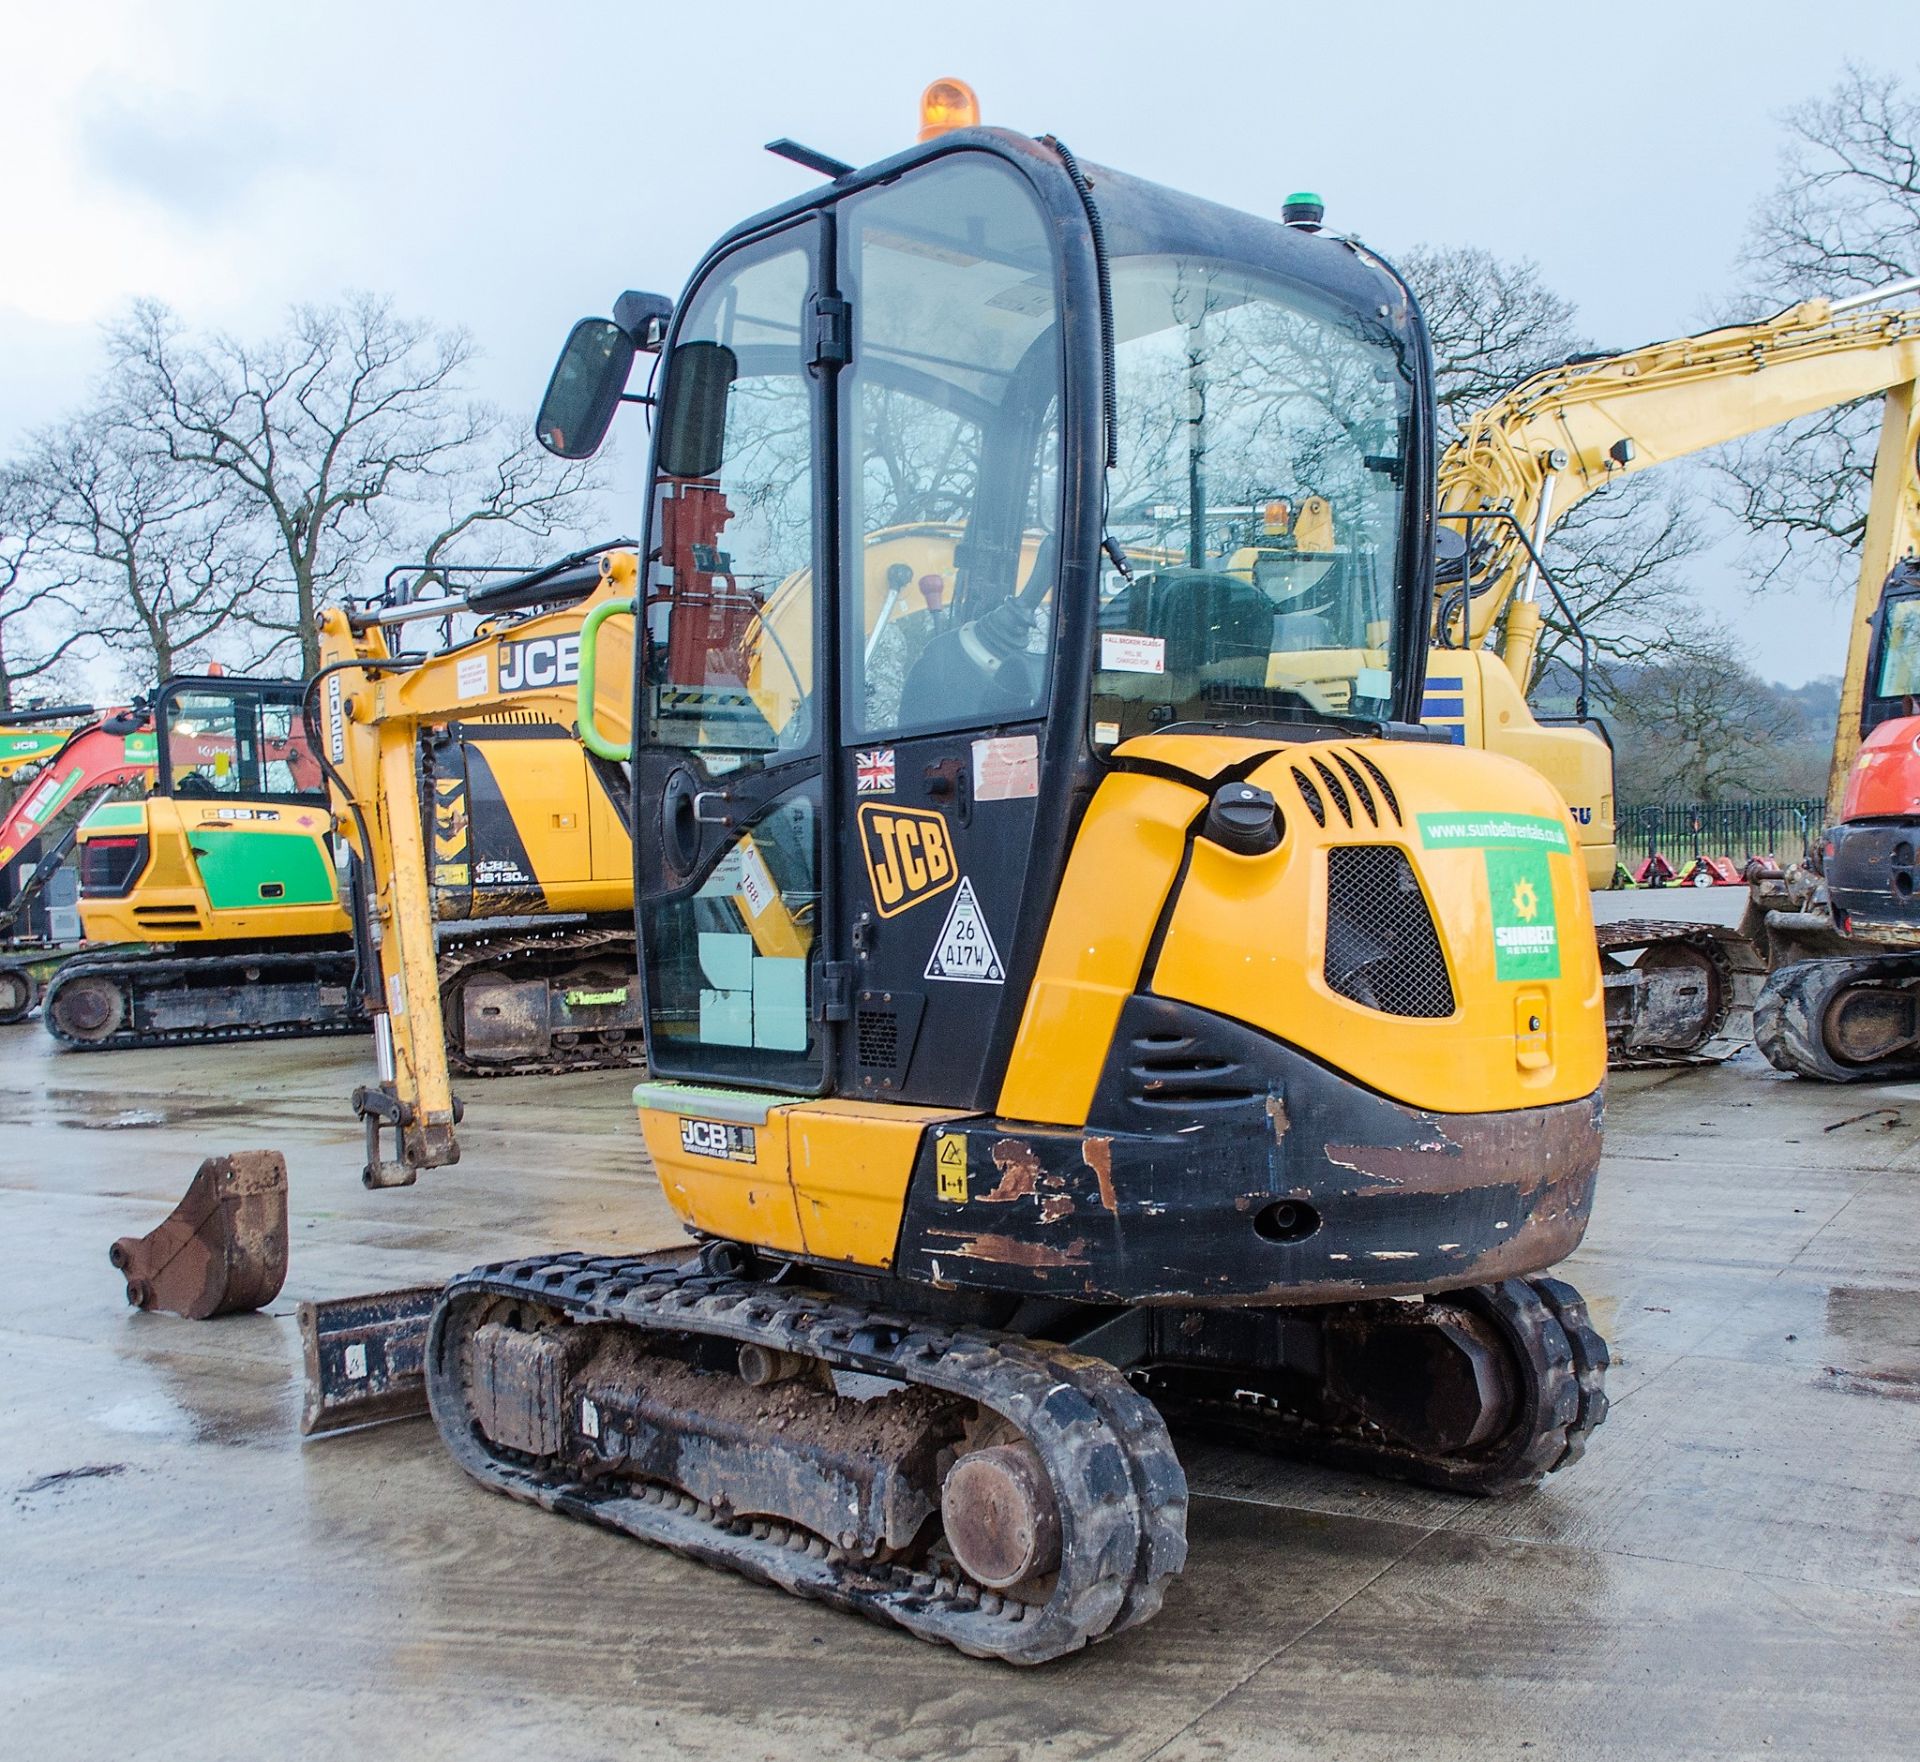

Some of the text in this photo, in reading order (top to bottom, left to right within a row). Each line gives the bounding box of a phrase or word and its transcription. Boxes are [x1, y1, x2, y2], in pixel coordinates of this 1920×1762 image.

[872, 815, 949, 905] JCB
[956, 920, 975, 940] 26
[1495, 926, 1556, 946] SUNBELT
[1506, 946, 1551, 955] RENTALS
[682, 1120, 728, 1150] JCB
